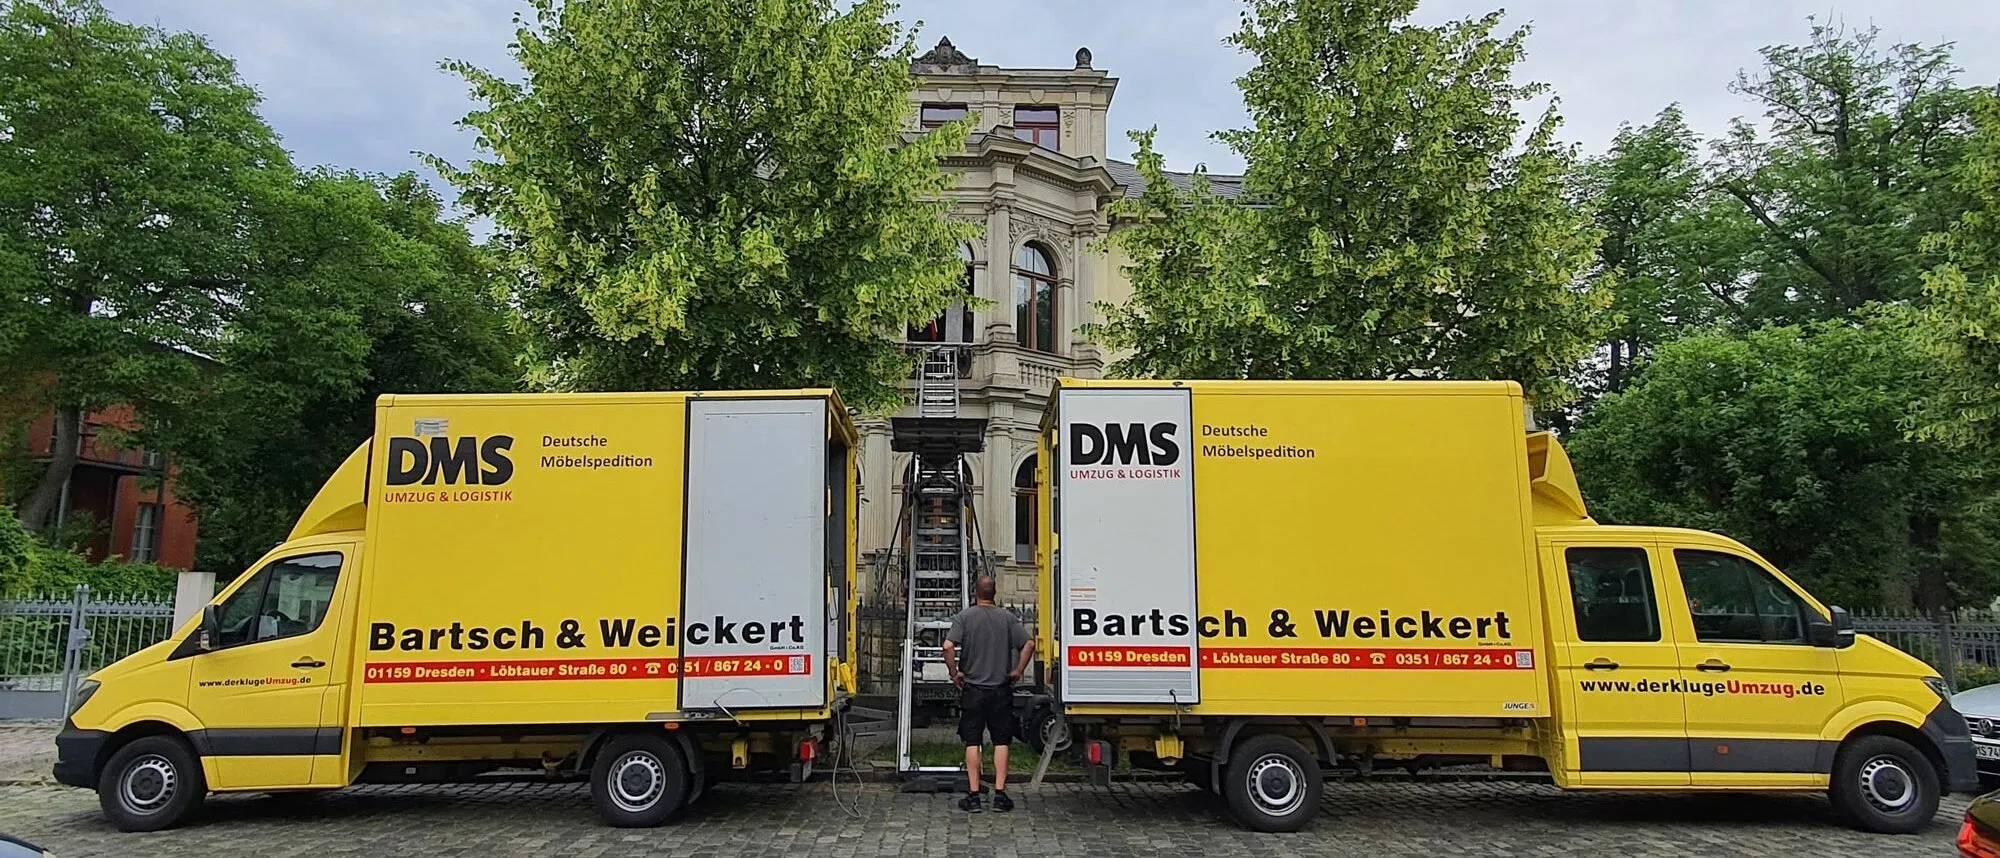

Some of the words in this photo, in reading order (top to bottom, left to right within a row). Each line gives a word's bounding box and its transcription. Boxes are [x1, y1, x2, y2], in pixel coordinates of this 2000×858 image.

[1202, 424, 1268, 437] Deutsche
[542, 434, 608, 447] Deutsche
[1070, 422, 1180, 466] DMS
[386, 435, 514, 485] DMS
[1202, 445, 1315, 460] Möbelspedition
[540, 454, 653, 470] Möbelspedition
[1070, 470, 1114, 479] UMZUG
[1117, 469, 1126, 479] &
[1129, 469, 1181, 479] LOGISTIK
[385, 491, 436, 503] UMZUG
[440, 491, 449, 502] &
[453, 490, 513, 502] LOGISTIK
[1073, 608, 1247, 638] Bartsch
[1268, 609, 1299, 638] &
[1314, 609, 1511, 639] Weickert
[369, 621, 544, 651] Bartsch
[556, 619, 587, 649] &
[599, 615, 804, 648] Weickert
[1079, 651, 1122, 662] 01159
[1126, 651, 1186, 662] Dresden
[1213, 652, 1277, 664] Löbtauer
[1281, 652, 1328, 664] Straße
[1332, 653, 1350, 664] 80
[1396, 653, 1430, 665] 0351
[1435, 653, 1440, 666] /
[1443, 653, 1469, 665] 867
[1473, 654, 1491, 665] 24
[1503, 654, 1513, 665] 0
[368, 667, 411, 679] 01159
[415, 666, 475, 678] Dresden
[490, 665, 554, 677] Löbtauer
[558, 664, 606, 676] Straße
[609, 663, 627, 675] 80
[668, 661, 700, 674] 051
[705, 660, 711, 673] /
[714, 660, 740, 672] 867
[744, 660, 761, 671] 24
[773, 659, 783, 671] 0
[199, 676, 311, 688] www.derklugeUmzug.de
[1580, 679, 1825, 698] www.derklugeUmzug.de
